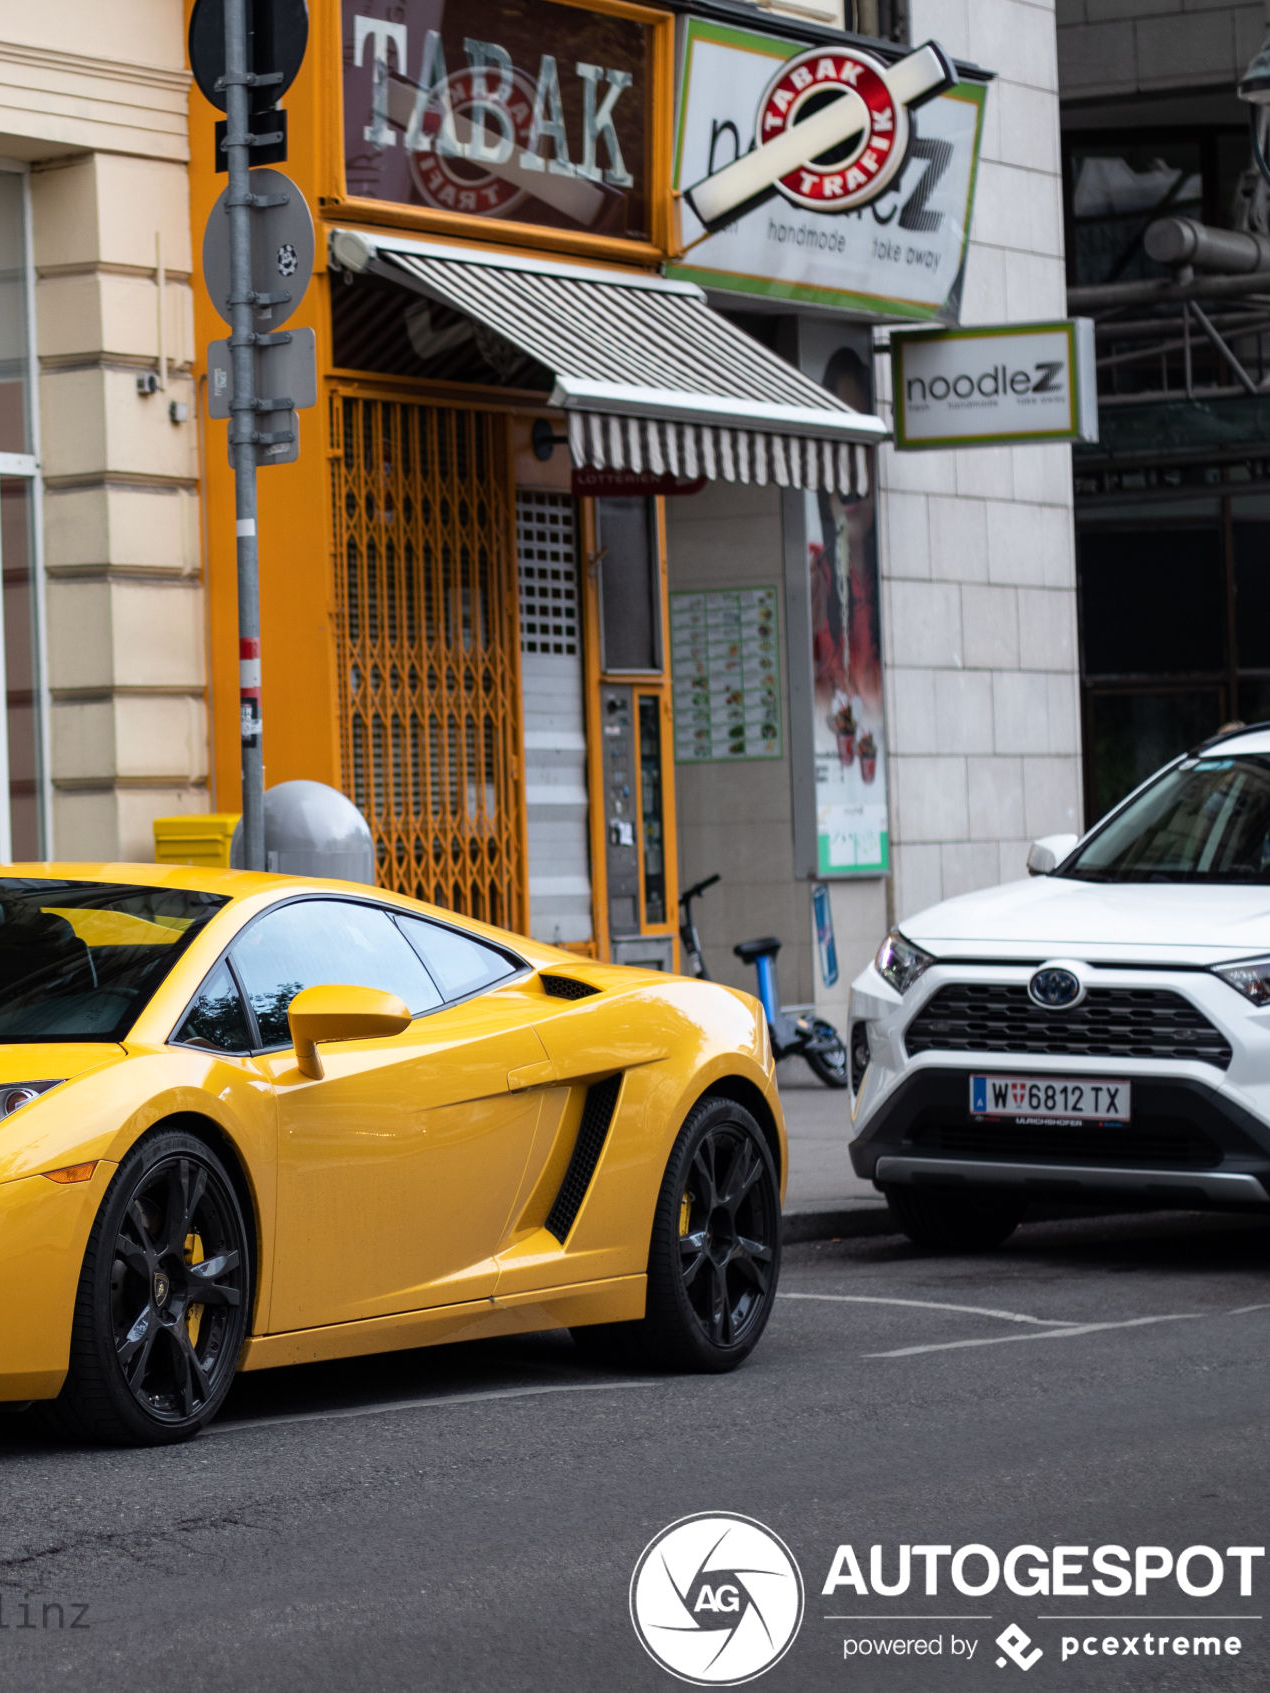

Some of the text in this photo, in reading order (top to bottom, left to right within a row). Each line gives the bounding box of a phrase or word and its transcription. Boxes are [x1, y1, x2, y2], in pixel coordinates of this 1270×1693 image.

[353, 14, 634, 188] TABAK
[764, 57, 865, 132] TABAK
[799, 106, 894, 198] TRAFIK
[768, 217, 847, 254] handmade
[872, 238, 901, 263] take
[905, 247, 942, 275] away
[907, 360, 1065, 401] noodleZ
[576, 473, 662, 486] LOTTERIEN
[992, 1082, 1120, 1114] W 6812 TX
